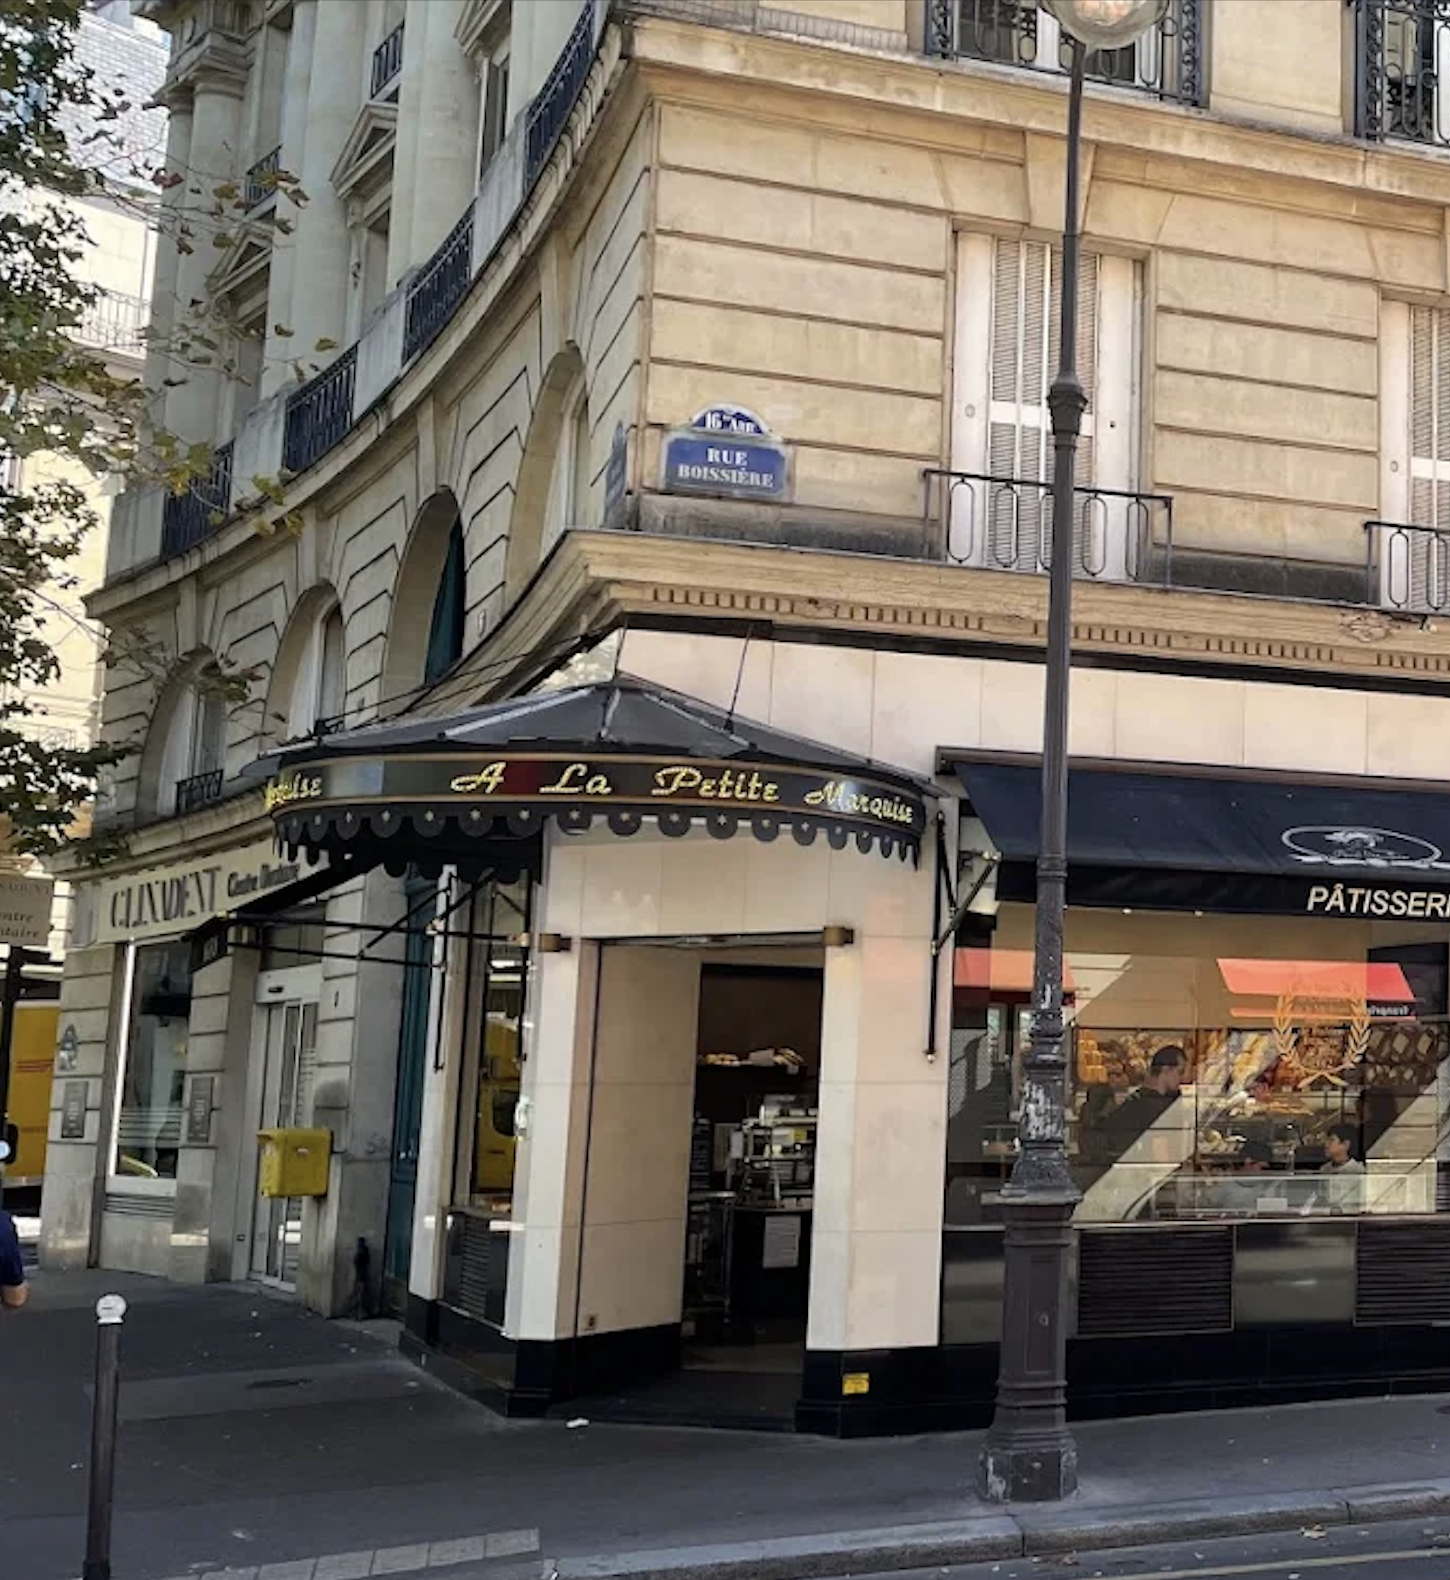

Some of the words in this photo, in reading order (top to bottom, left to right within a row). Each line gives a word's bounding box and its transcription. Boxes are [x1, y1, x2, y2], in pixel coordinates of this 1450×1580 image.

[707, 448, 747, 465] RUE
[677, 464, 774, 488] BOISSIÈRE
[450, 761, 507, 794] A
[538, 763, 612, 796] La
[650, 765, 781, 802] Petite
[803, 780, 914, 824] Marquise
